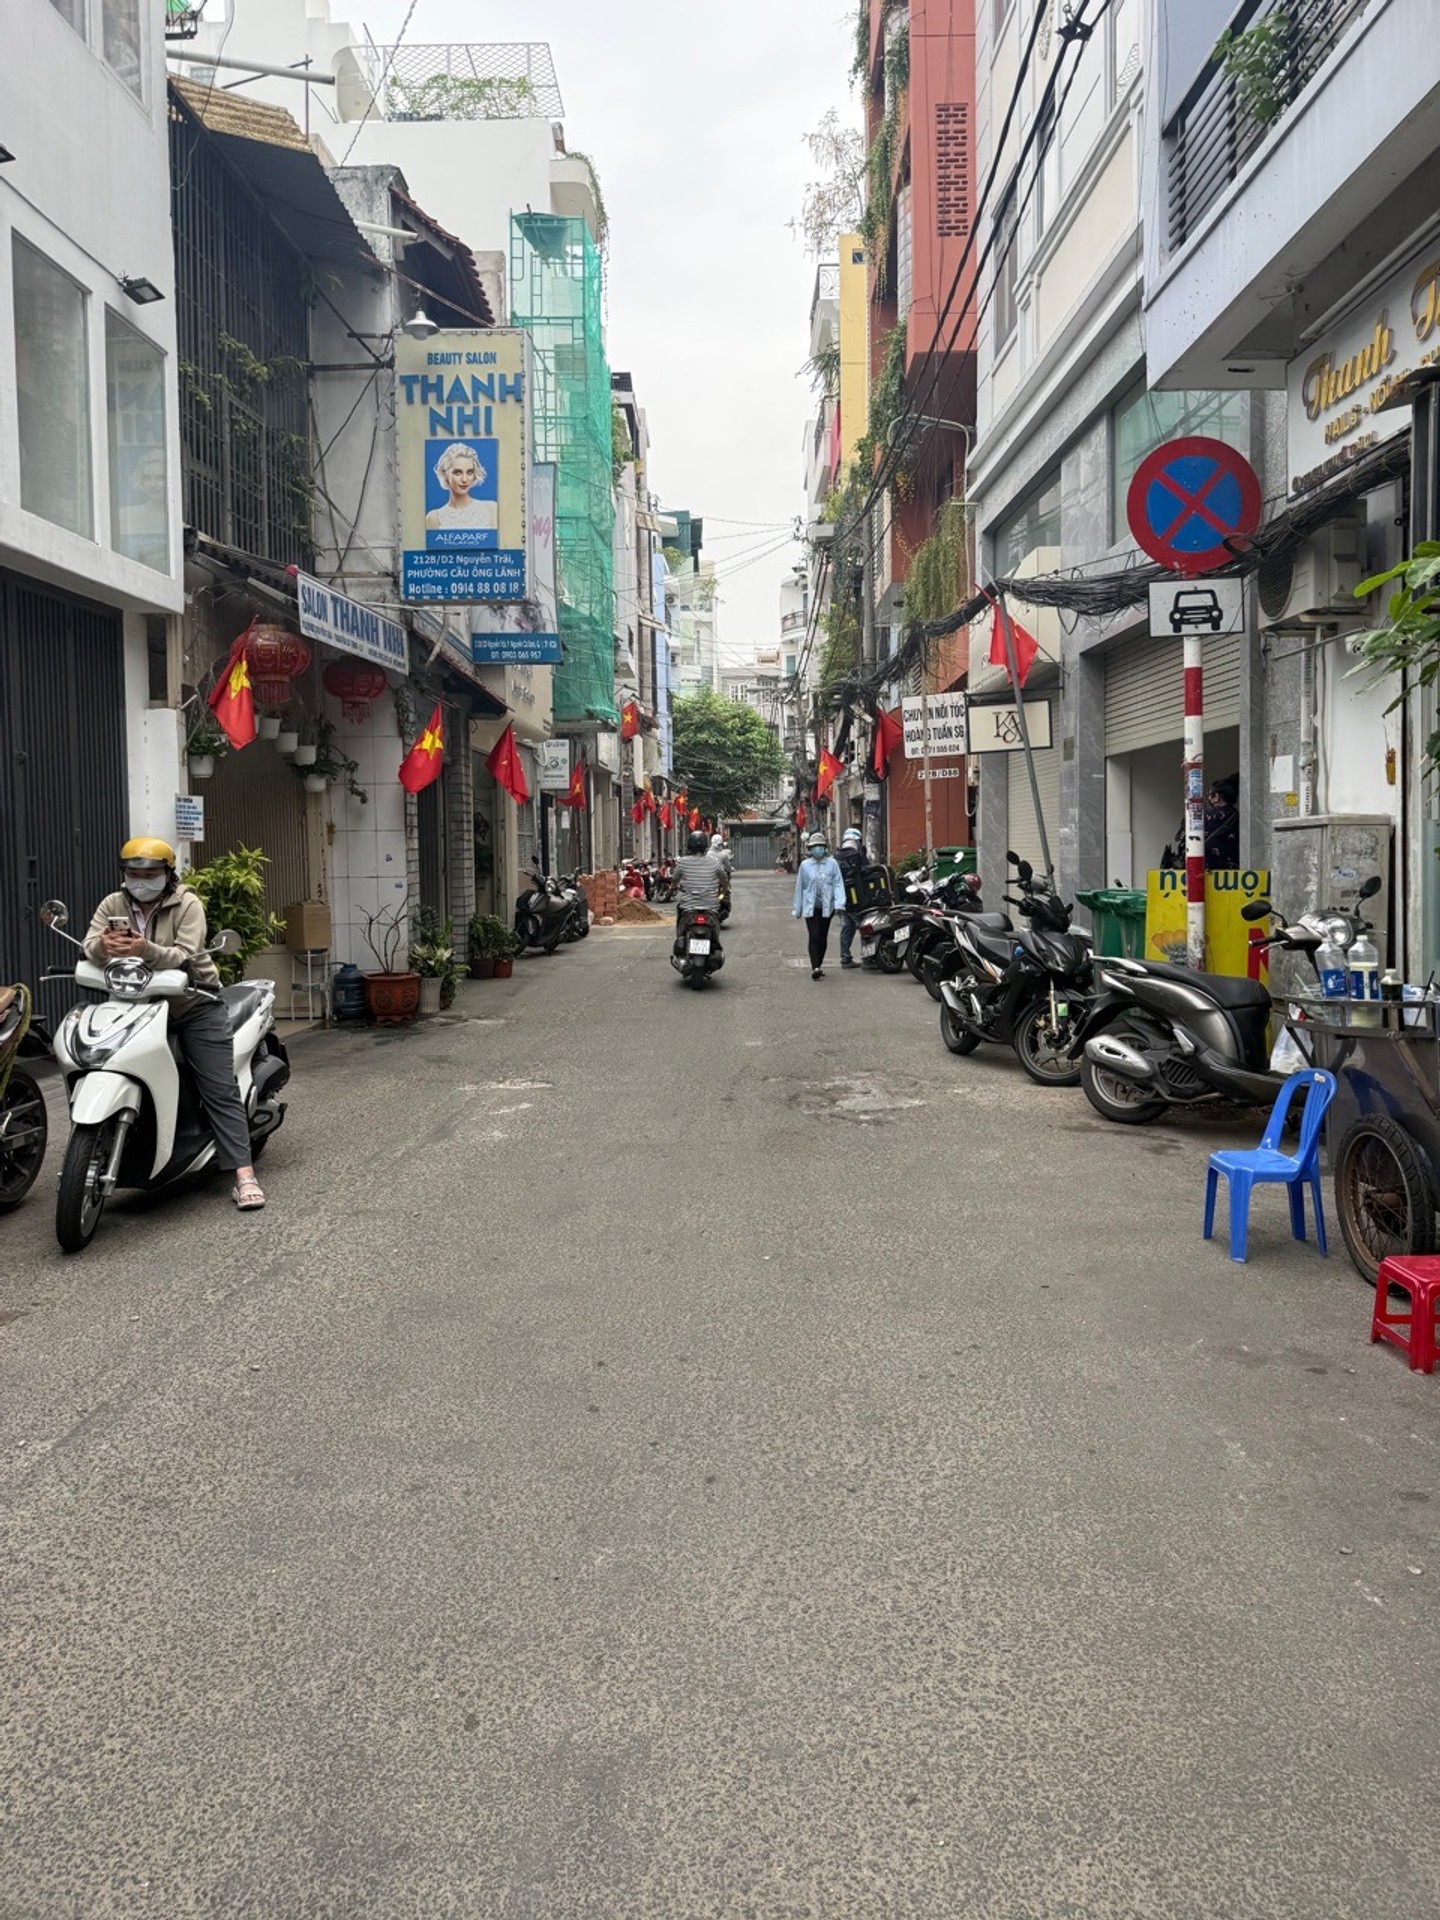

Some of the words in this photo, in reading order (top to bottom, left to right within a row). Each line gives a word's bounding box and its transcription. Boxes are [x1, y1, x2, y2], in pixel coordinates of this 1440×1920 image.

[427, 352, 462, 365] BEAUTY
[465, 351, 497, 364] SALON
[1302, 308, 1397, 421] Thanh
[399, 372, 523, 405] THANH
[429, 405, 493, 436] NHI
[435, 532, 489, 541] ALFAPARF
[413, 555, 454, 565] 212B/D2
[456, 552, 492, 566] Nguyễn
[493, 554, 514, 565] Trãi,
[471, 567, 493, 578] ÔNG
[409, 583, 443, 594] Hotline
[450, 583, 474, 594] 0914
[301, 584, 329, 623] SALON
[330, 594, 381, 649] THANH
[903, 707, 934, 722] CHUYN
[954, 724, 965, 739] SG
